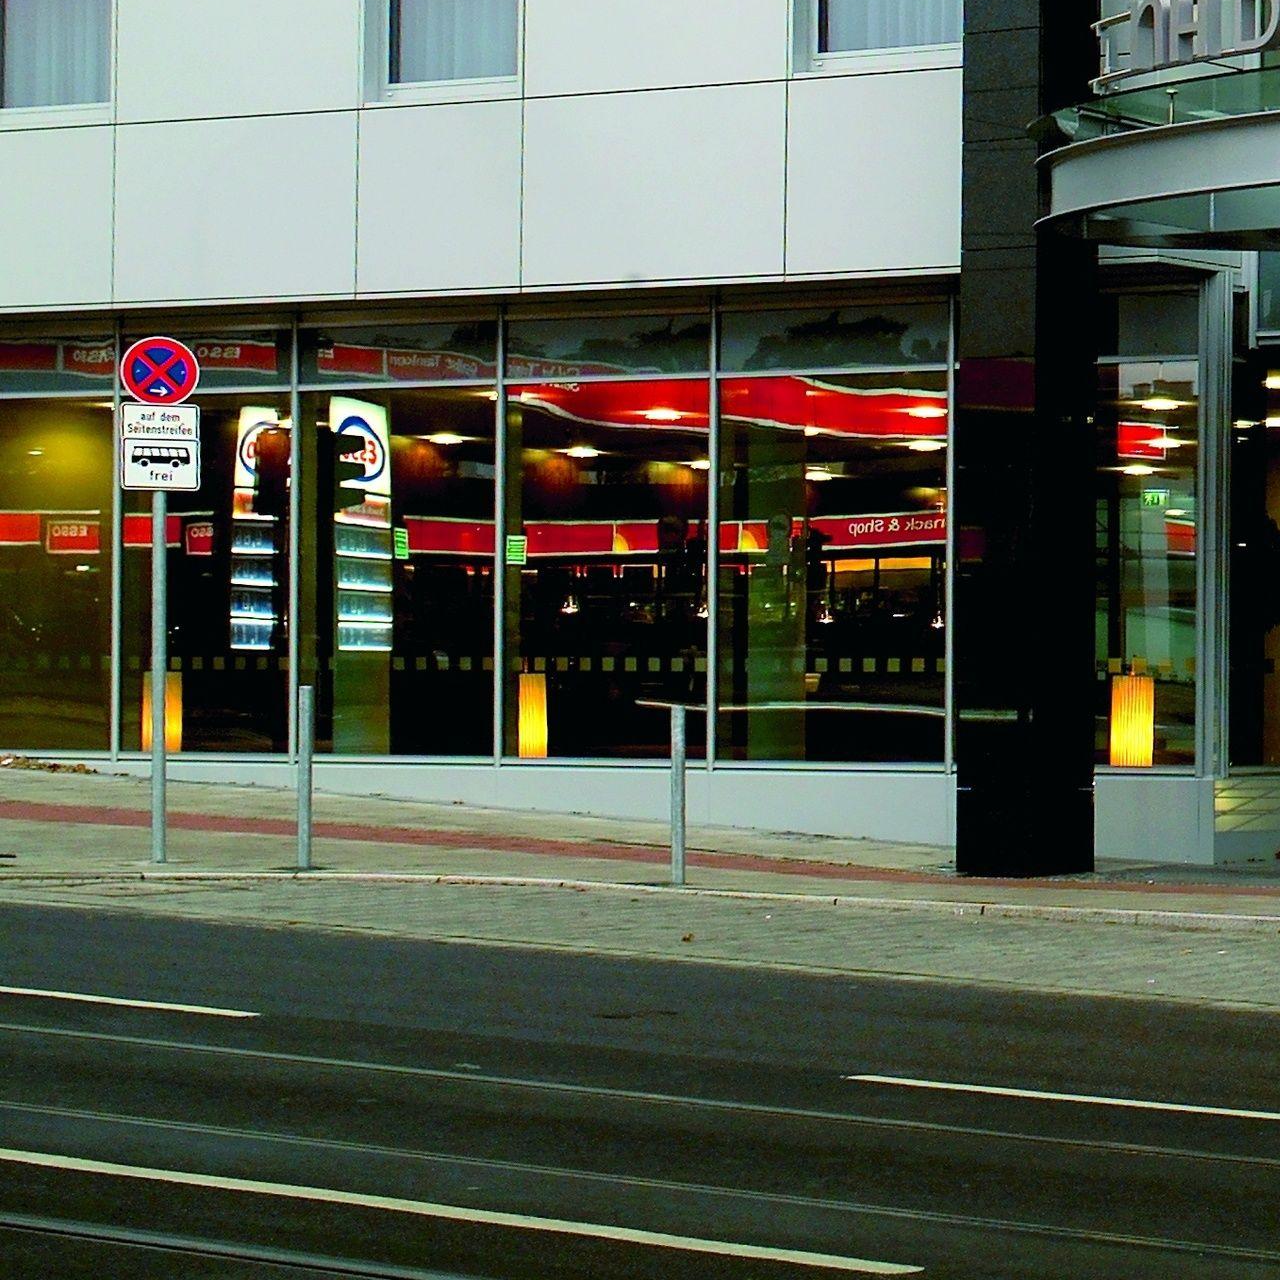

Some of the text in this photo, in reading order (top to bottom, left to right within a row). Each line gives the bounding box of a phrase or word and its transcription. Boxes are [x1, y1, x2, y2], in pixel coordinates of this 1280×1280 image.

[140, 412, 180, 422] auf dem
[127, 421, 193, 436] Seitenstreifen
[149, 470, 173, 481] frei
